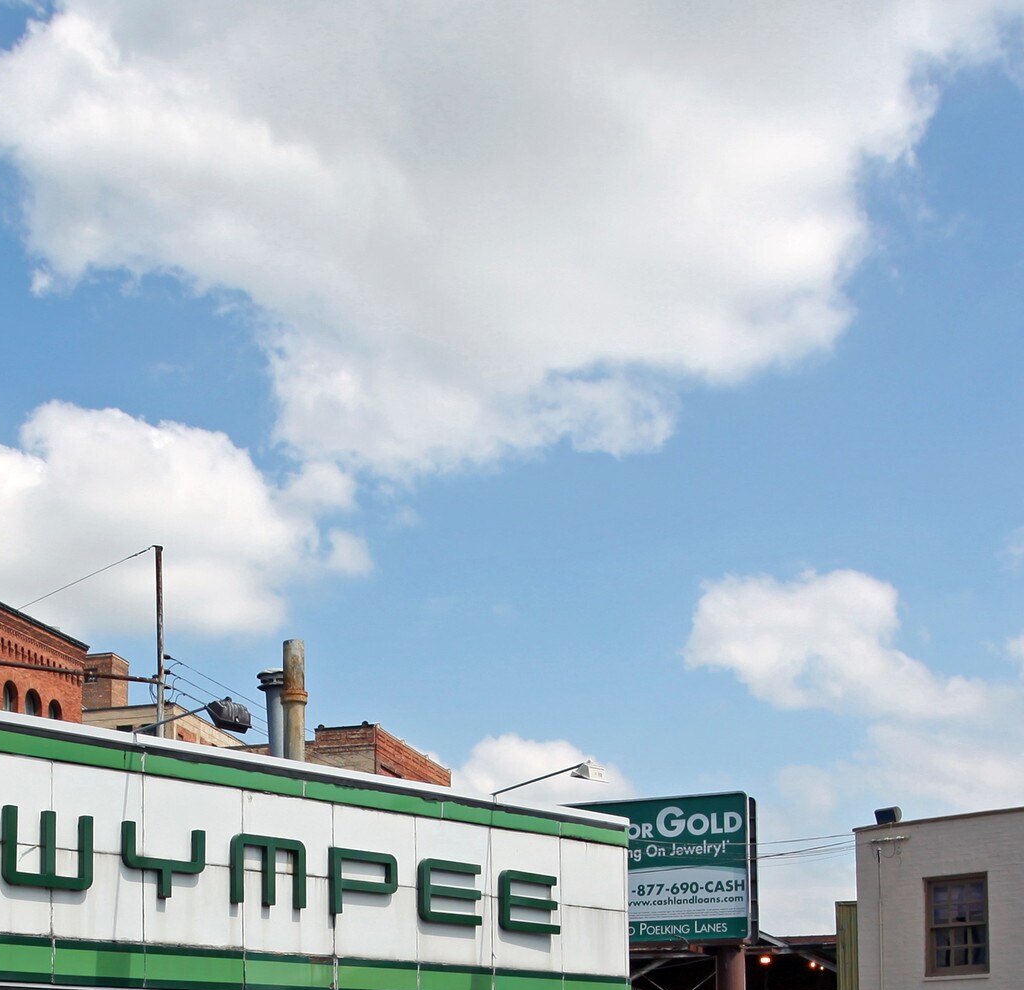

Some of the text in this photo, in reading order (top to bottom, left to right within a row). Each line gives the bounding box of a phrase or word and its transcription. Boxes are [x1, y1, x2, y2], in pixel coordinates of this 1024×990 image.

[656, 806, 743, 838] GOLD
[645, 844, 666, 858] On
[1, 804, 561, 936] WYMPEE
[694, 920, 728, 933] LANES
